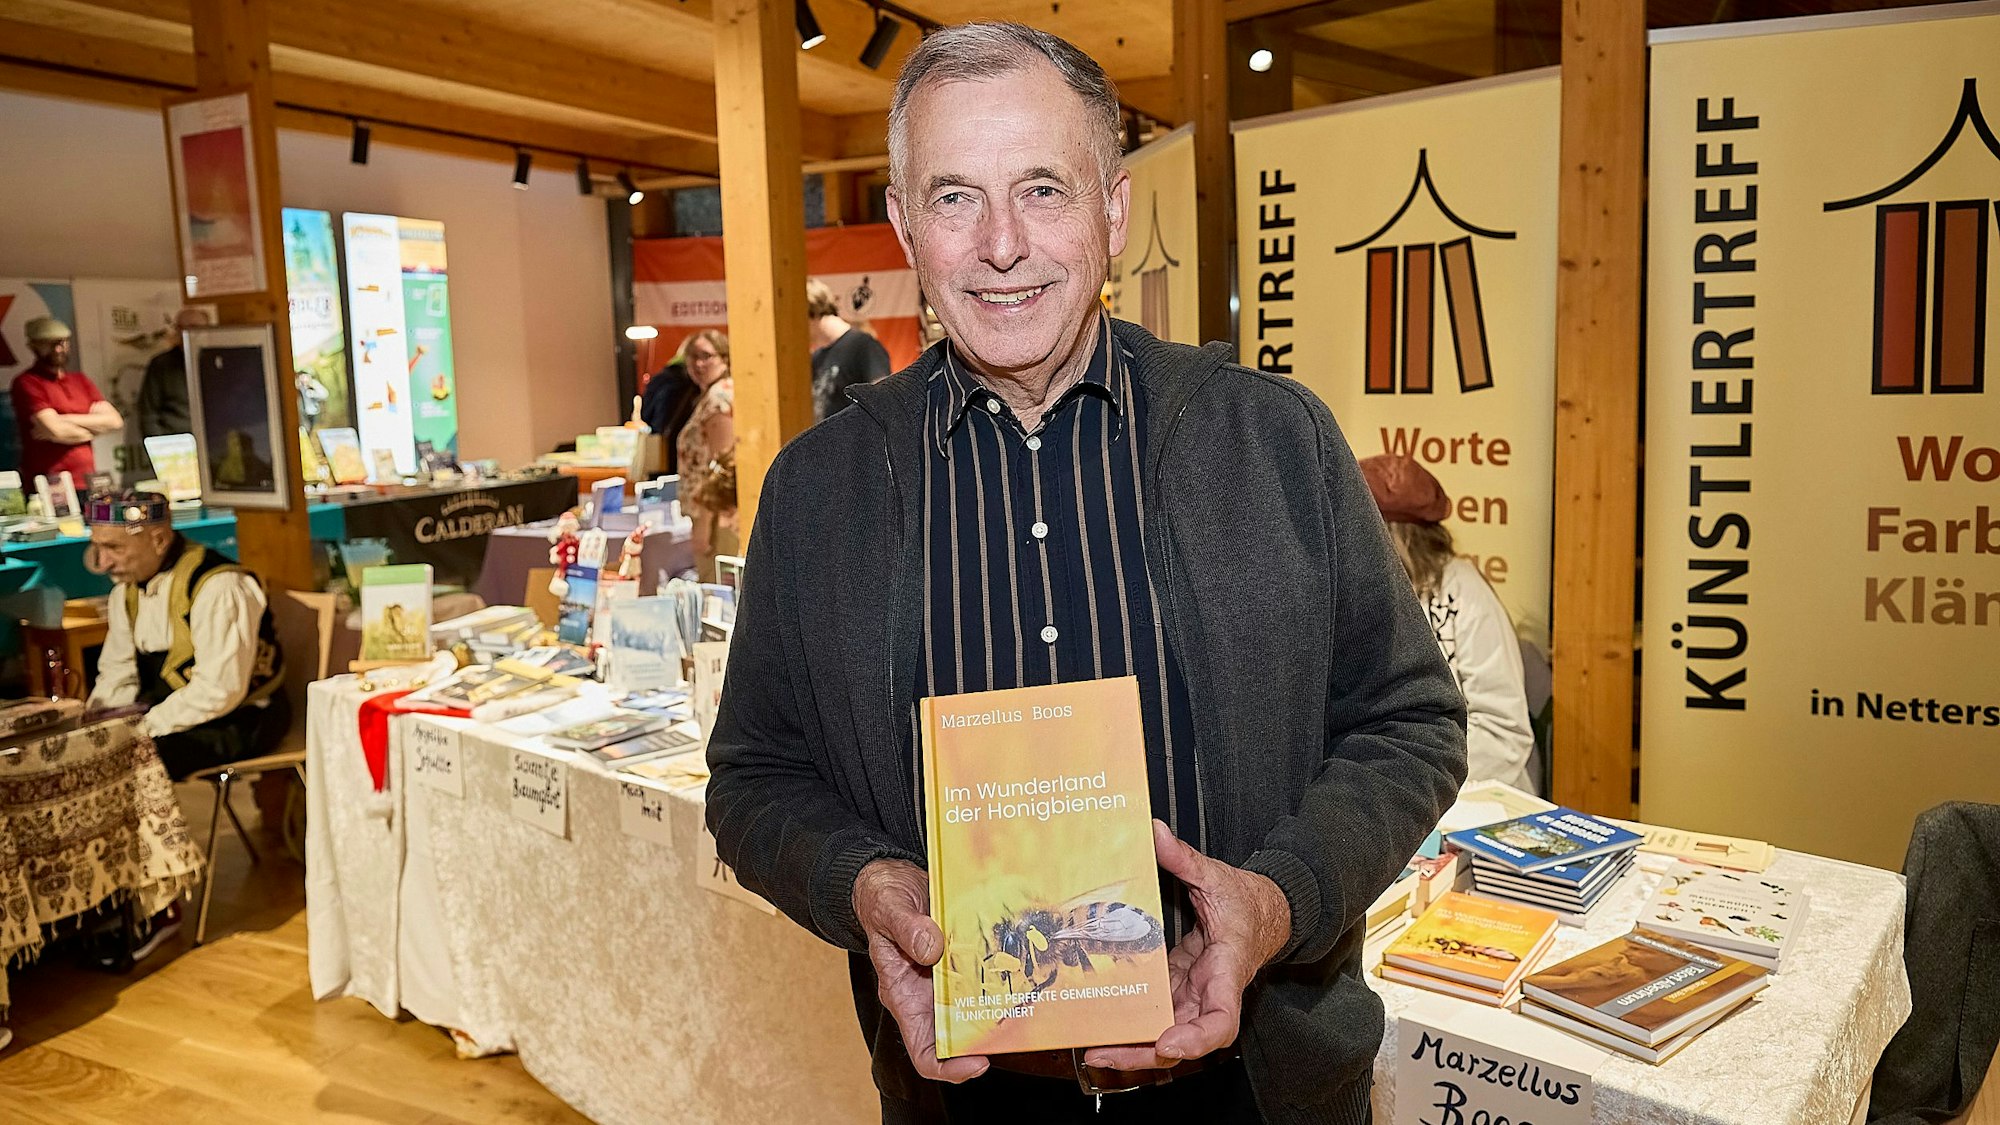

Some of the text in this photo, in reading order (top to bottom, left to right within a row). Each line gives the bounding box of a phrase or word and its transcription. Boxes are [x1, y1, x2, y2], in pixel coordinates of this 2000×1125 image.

[1671, 97, 1760, 711] KÜNSTLERTREFF
[1380, 427, 1511, 466] Worte
[1896, 436, 2000, 482] Wo
[941, 704, 1073, 729] Marzellus Boos
[1811, 688, 2000, 727] in Netters
[944, 771, 1106, 802] Im Wunderland
[945, 792, 1126, 824] der Honigbienen
[954, 983, 1149, 1008] WIE EINE PERFEKTE GEMEINSCHAFT
[954, 1005, 1035, 1022] FUNKTIONIERT
[1411, 1031, 1582, 1105] Marzellus
